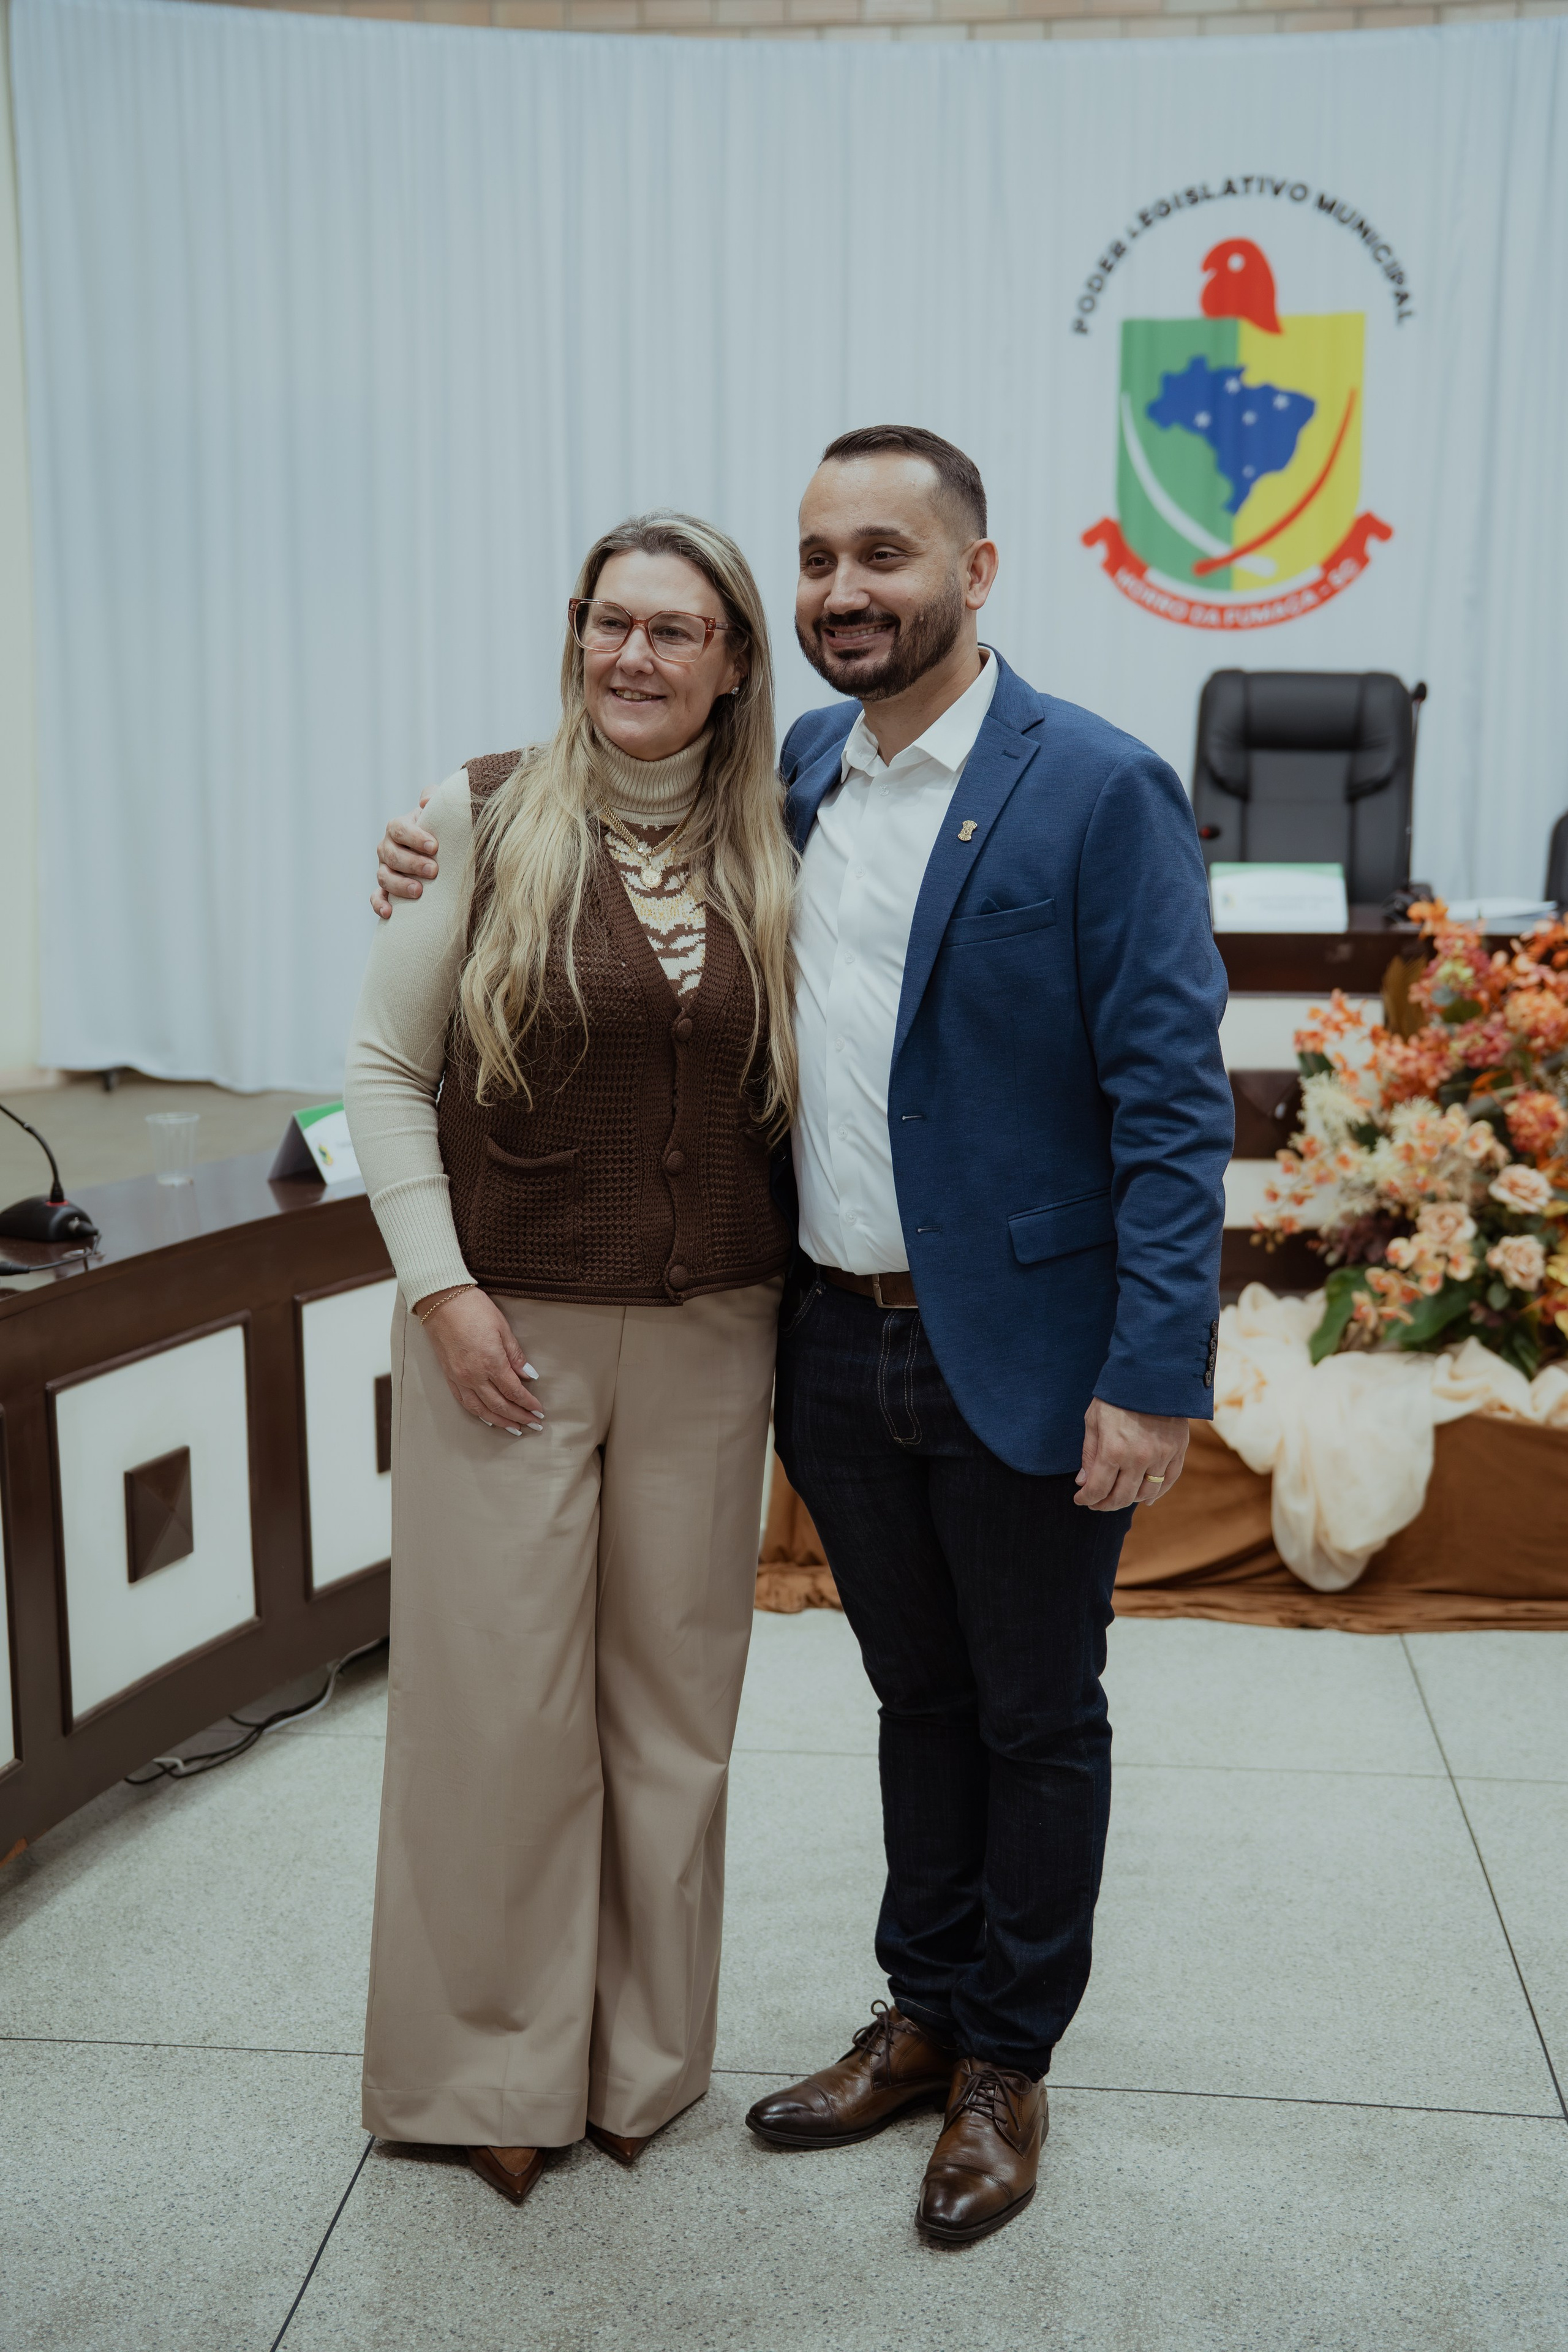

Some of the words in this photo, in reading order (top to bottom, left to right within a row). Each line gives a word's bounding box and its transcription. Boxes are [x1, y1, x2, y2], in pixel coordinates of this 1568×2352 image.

[1073, 241, 1127, 335] PODER
[1128, 175, 1310, 239] LEGISLATIVO
[1316, 192, 1414, 326] MUNICIPAL
[1189, 605, 1221, 625] DA
